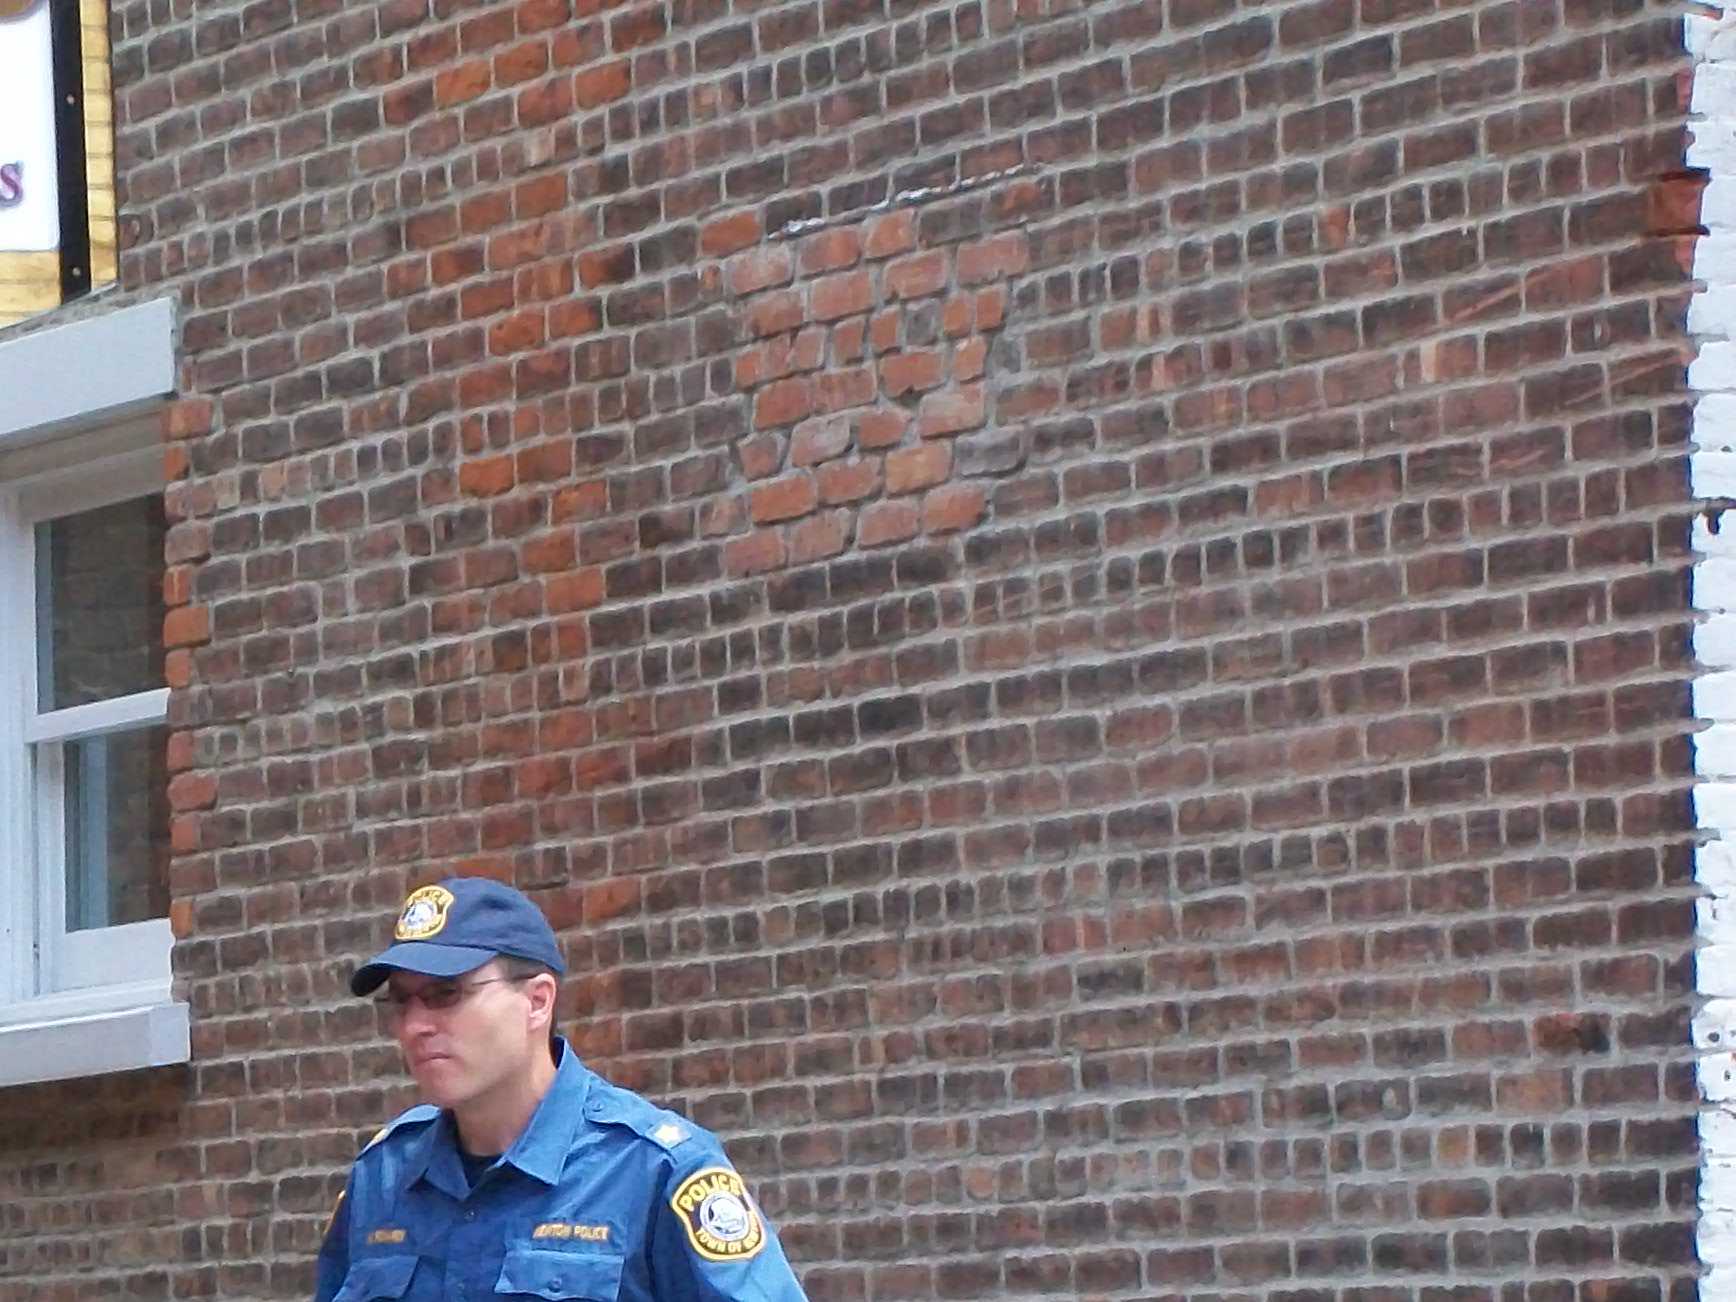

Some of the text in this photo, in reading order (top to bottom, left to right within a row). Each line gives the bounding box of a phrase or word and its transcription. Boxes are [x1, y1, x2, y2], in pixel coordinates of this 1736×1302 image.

[678, 1175, 742, 1212] POLICE
[574, 1225, 609, 1240] POLICE
[695, 1227, 726, 1253] TOWN
[727, 1241, 742, 1253] OF
